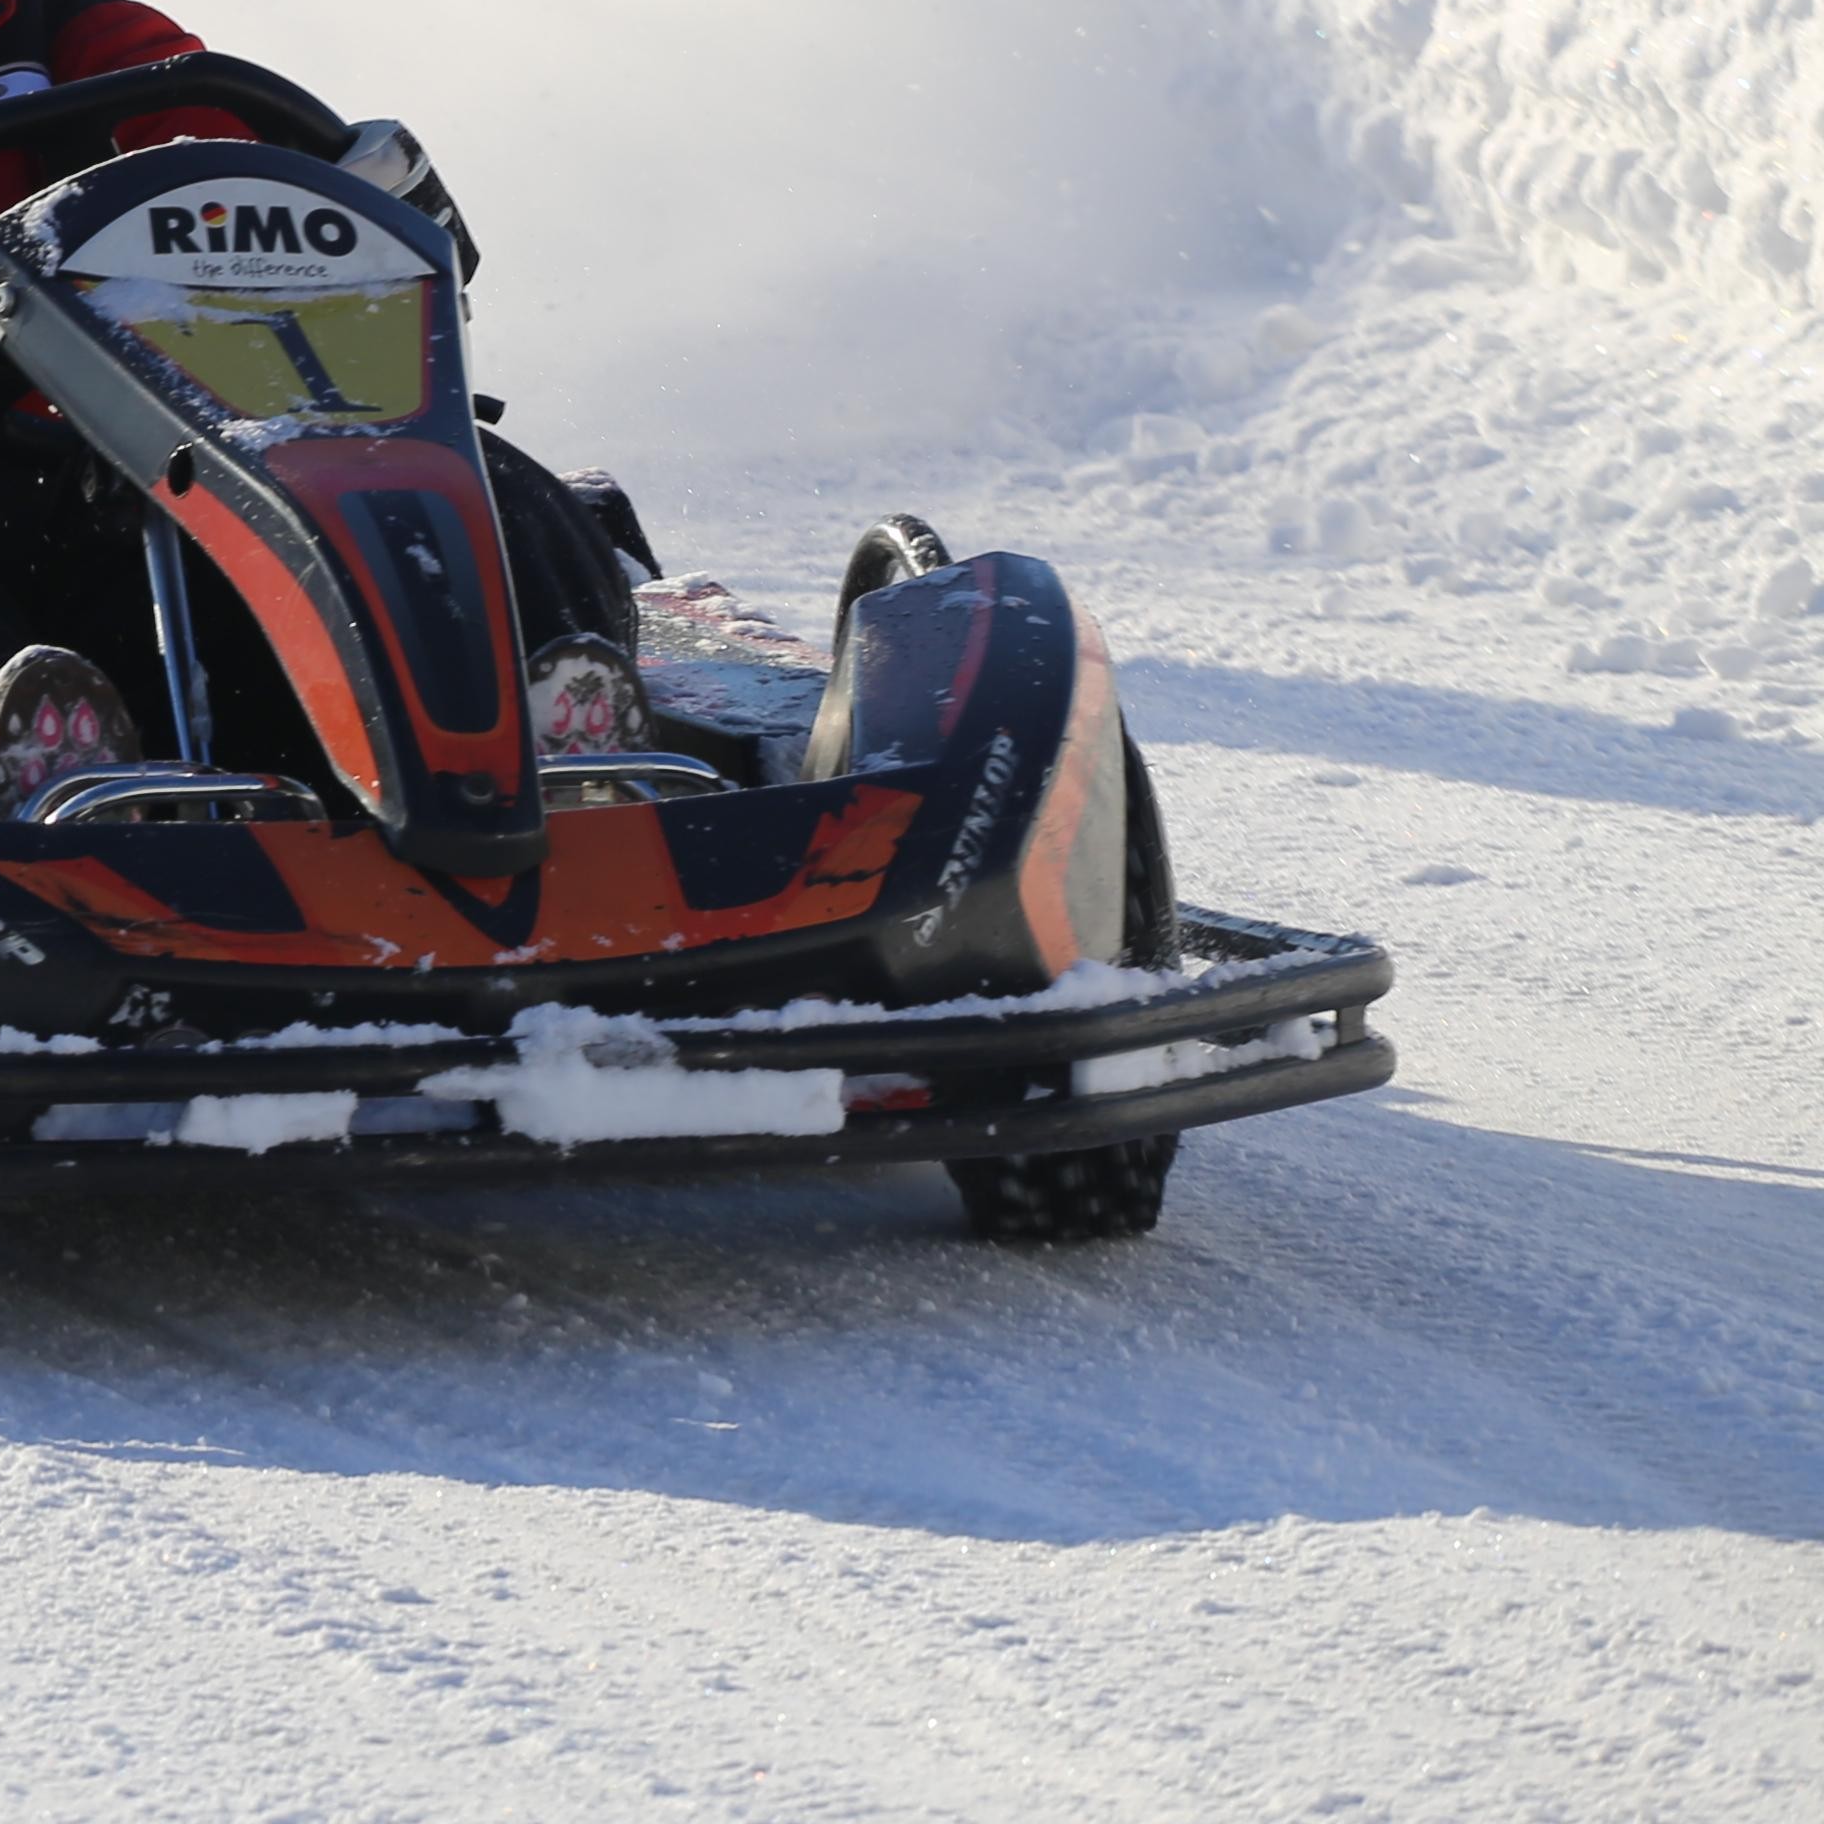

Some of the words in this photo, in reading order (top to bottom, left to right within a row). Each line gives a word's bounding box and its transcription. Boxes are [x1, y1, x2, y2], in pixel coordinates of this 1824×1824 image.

[148, 201, 358, 257] RiMO
[229, 255, 329, 278] difference
[229, 309, 383, 413] 1
[937, 733, 1016, 912] DUNLOP
